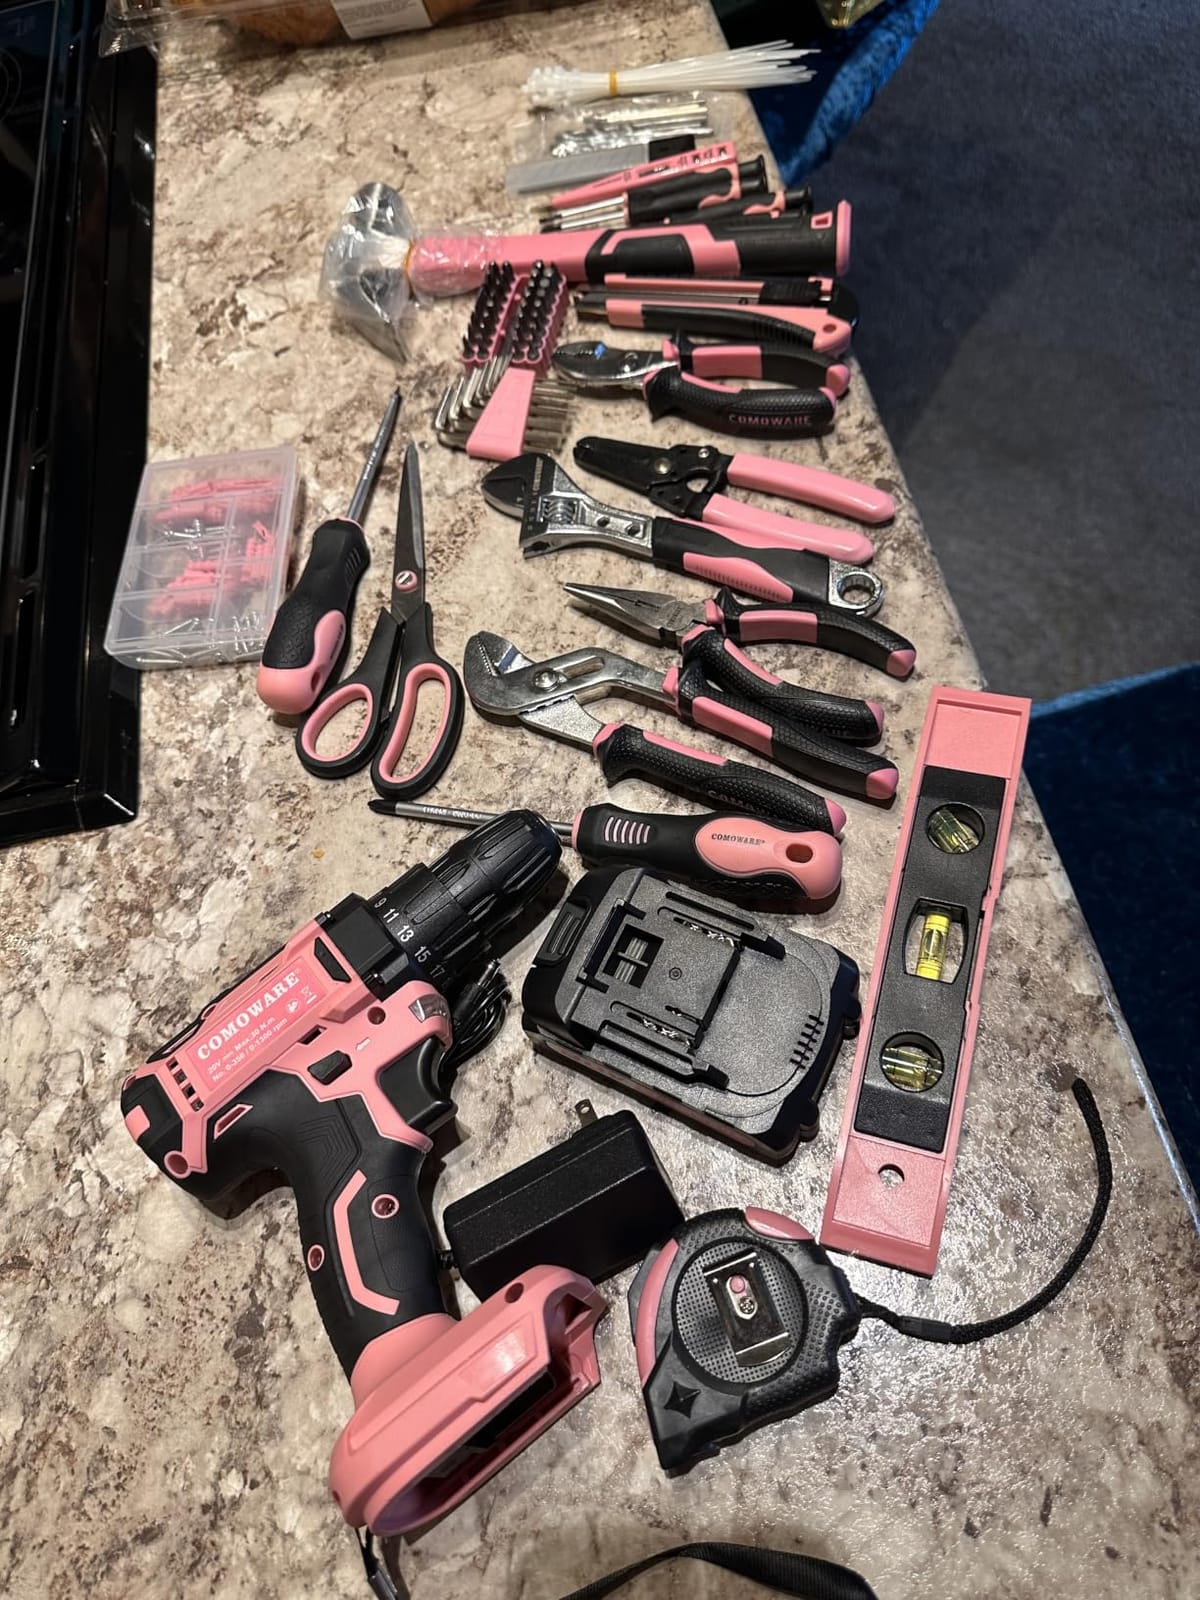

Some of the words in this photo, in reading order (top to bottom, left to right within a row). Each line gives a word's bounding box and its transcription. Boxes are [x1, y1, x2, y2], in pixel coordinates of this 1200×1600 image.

[374, 897, 388, 909] 9
[383, 908, 400, 923] 11
[397, 925, 415, 942] 13
[414, 946, 432, 963] 15
[430, 964, 446, 978] 17
[197, 971, 300, 1060] COMOWARE
